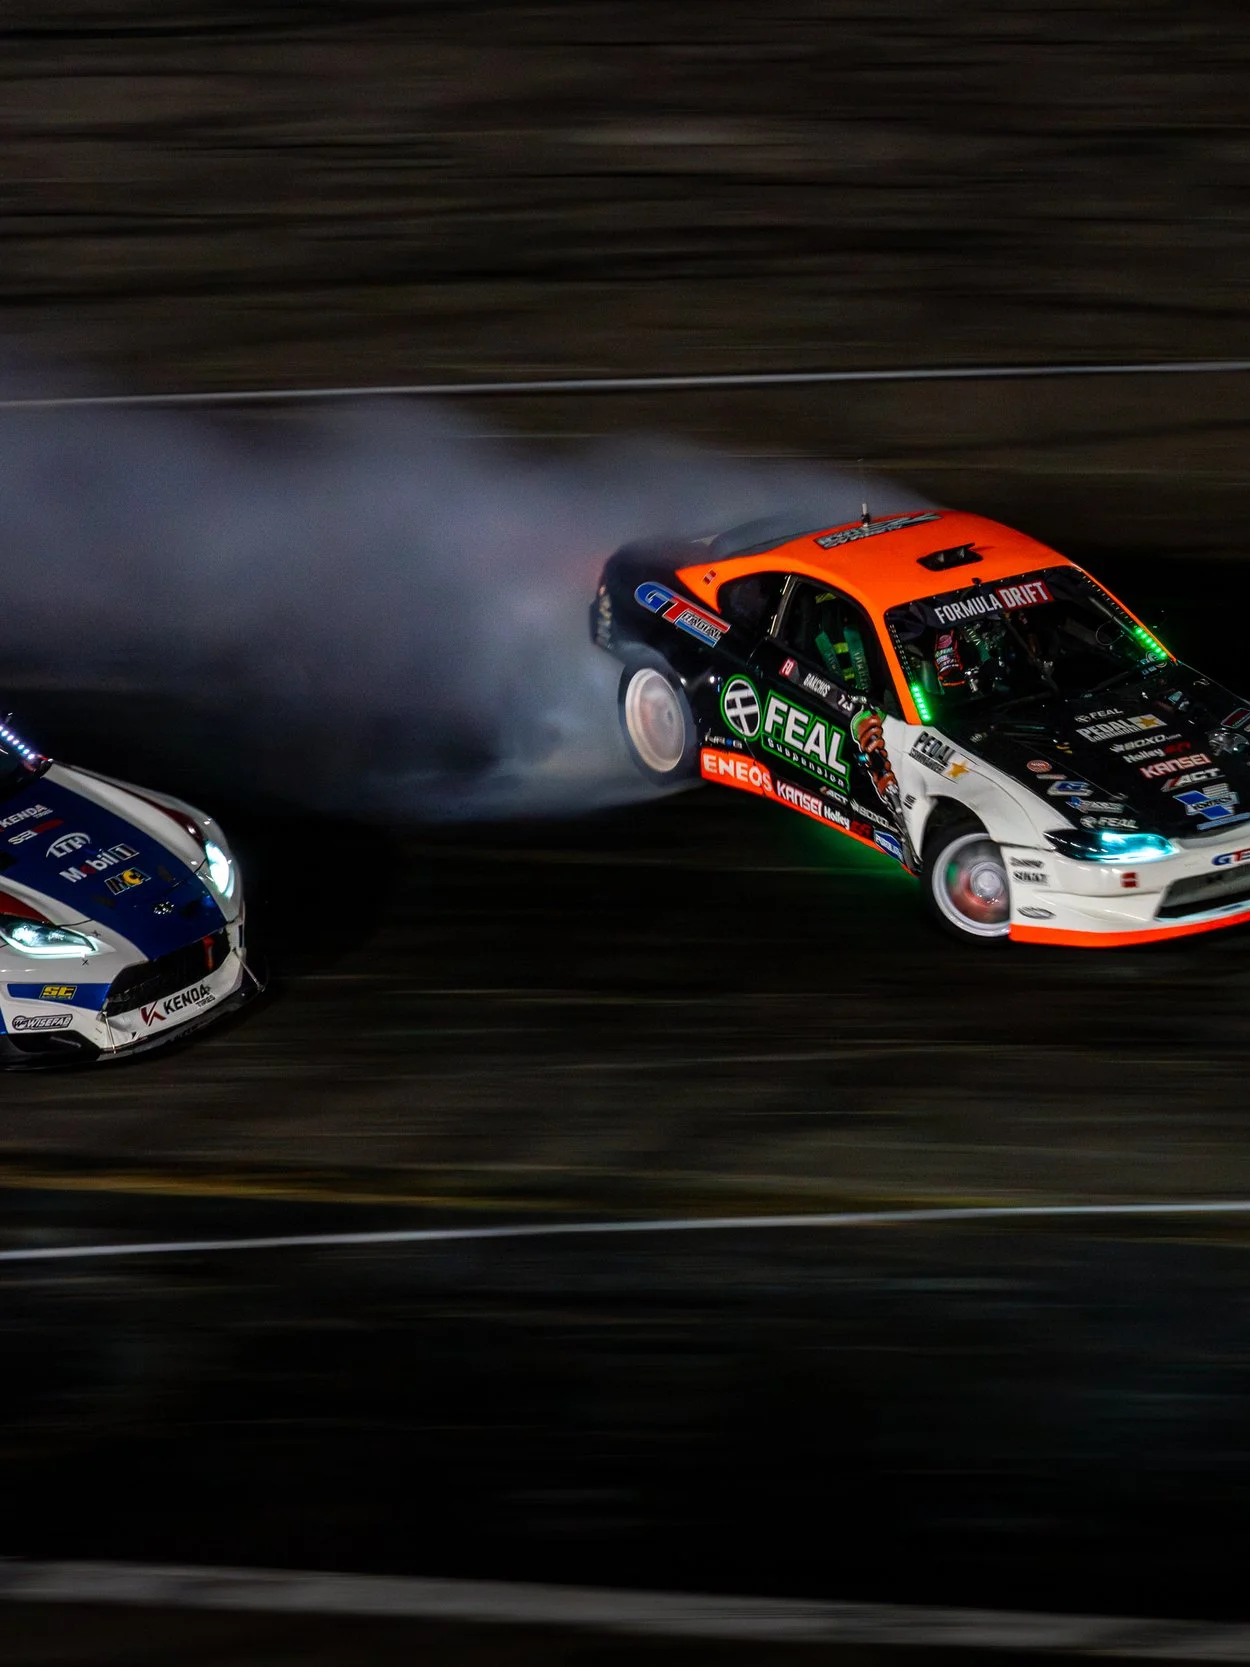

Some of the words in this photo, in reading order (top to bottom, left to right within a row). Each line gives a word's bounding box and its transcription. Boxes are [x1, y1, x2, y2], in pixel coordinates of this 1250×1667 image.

[634, 581, 731, 633] GT
[934, 594, 1003, 624] FORMULA
[999, 581, 1048, 608] DRIFT
[1089, 708, 1124, 720] FEAL
[764, 697, 847, 775] FEAL
[913, 731, 956, 767] PEDAL
[767, 736, 845, 788] Suspension
[1122, 748, 1166, 764] Holley
[1140, 753, 1212, 779] KANSEI
[703, 753, 773, 792] ENEOS
[1176, 768, 1221, 788] ACT
[777, 780, 823, 818] KANSEI
[1, 804, 48, 828] KENDA
[824, 806, 850, 831] Holley
[49, 836, 88, 858] LTH
[59, 848, 120, 883] Mobil
[163, 983, 211, 1015] KENDA
[26, 1014, 70, 1029] WISEFAB
